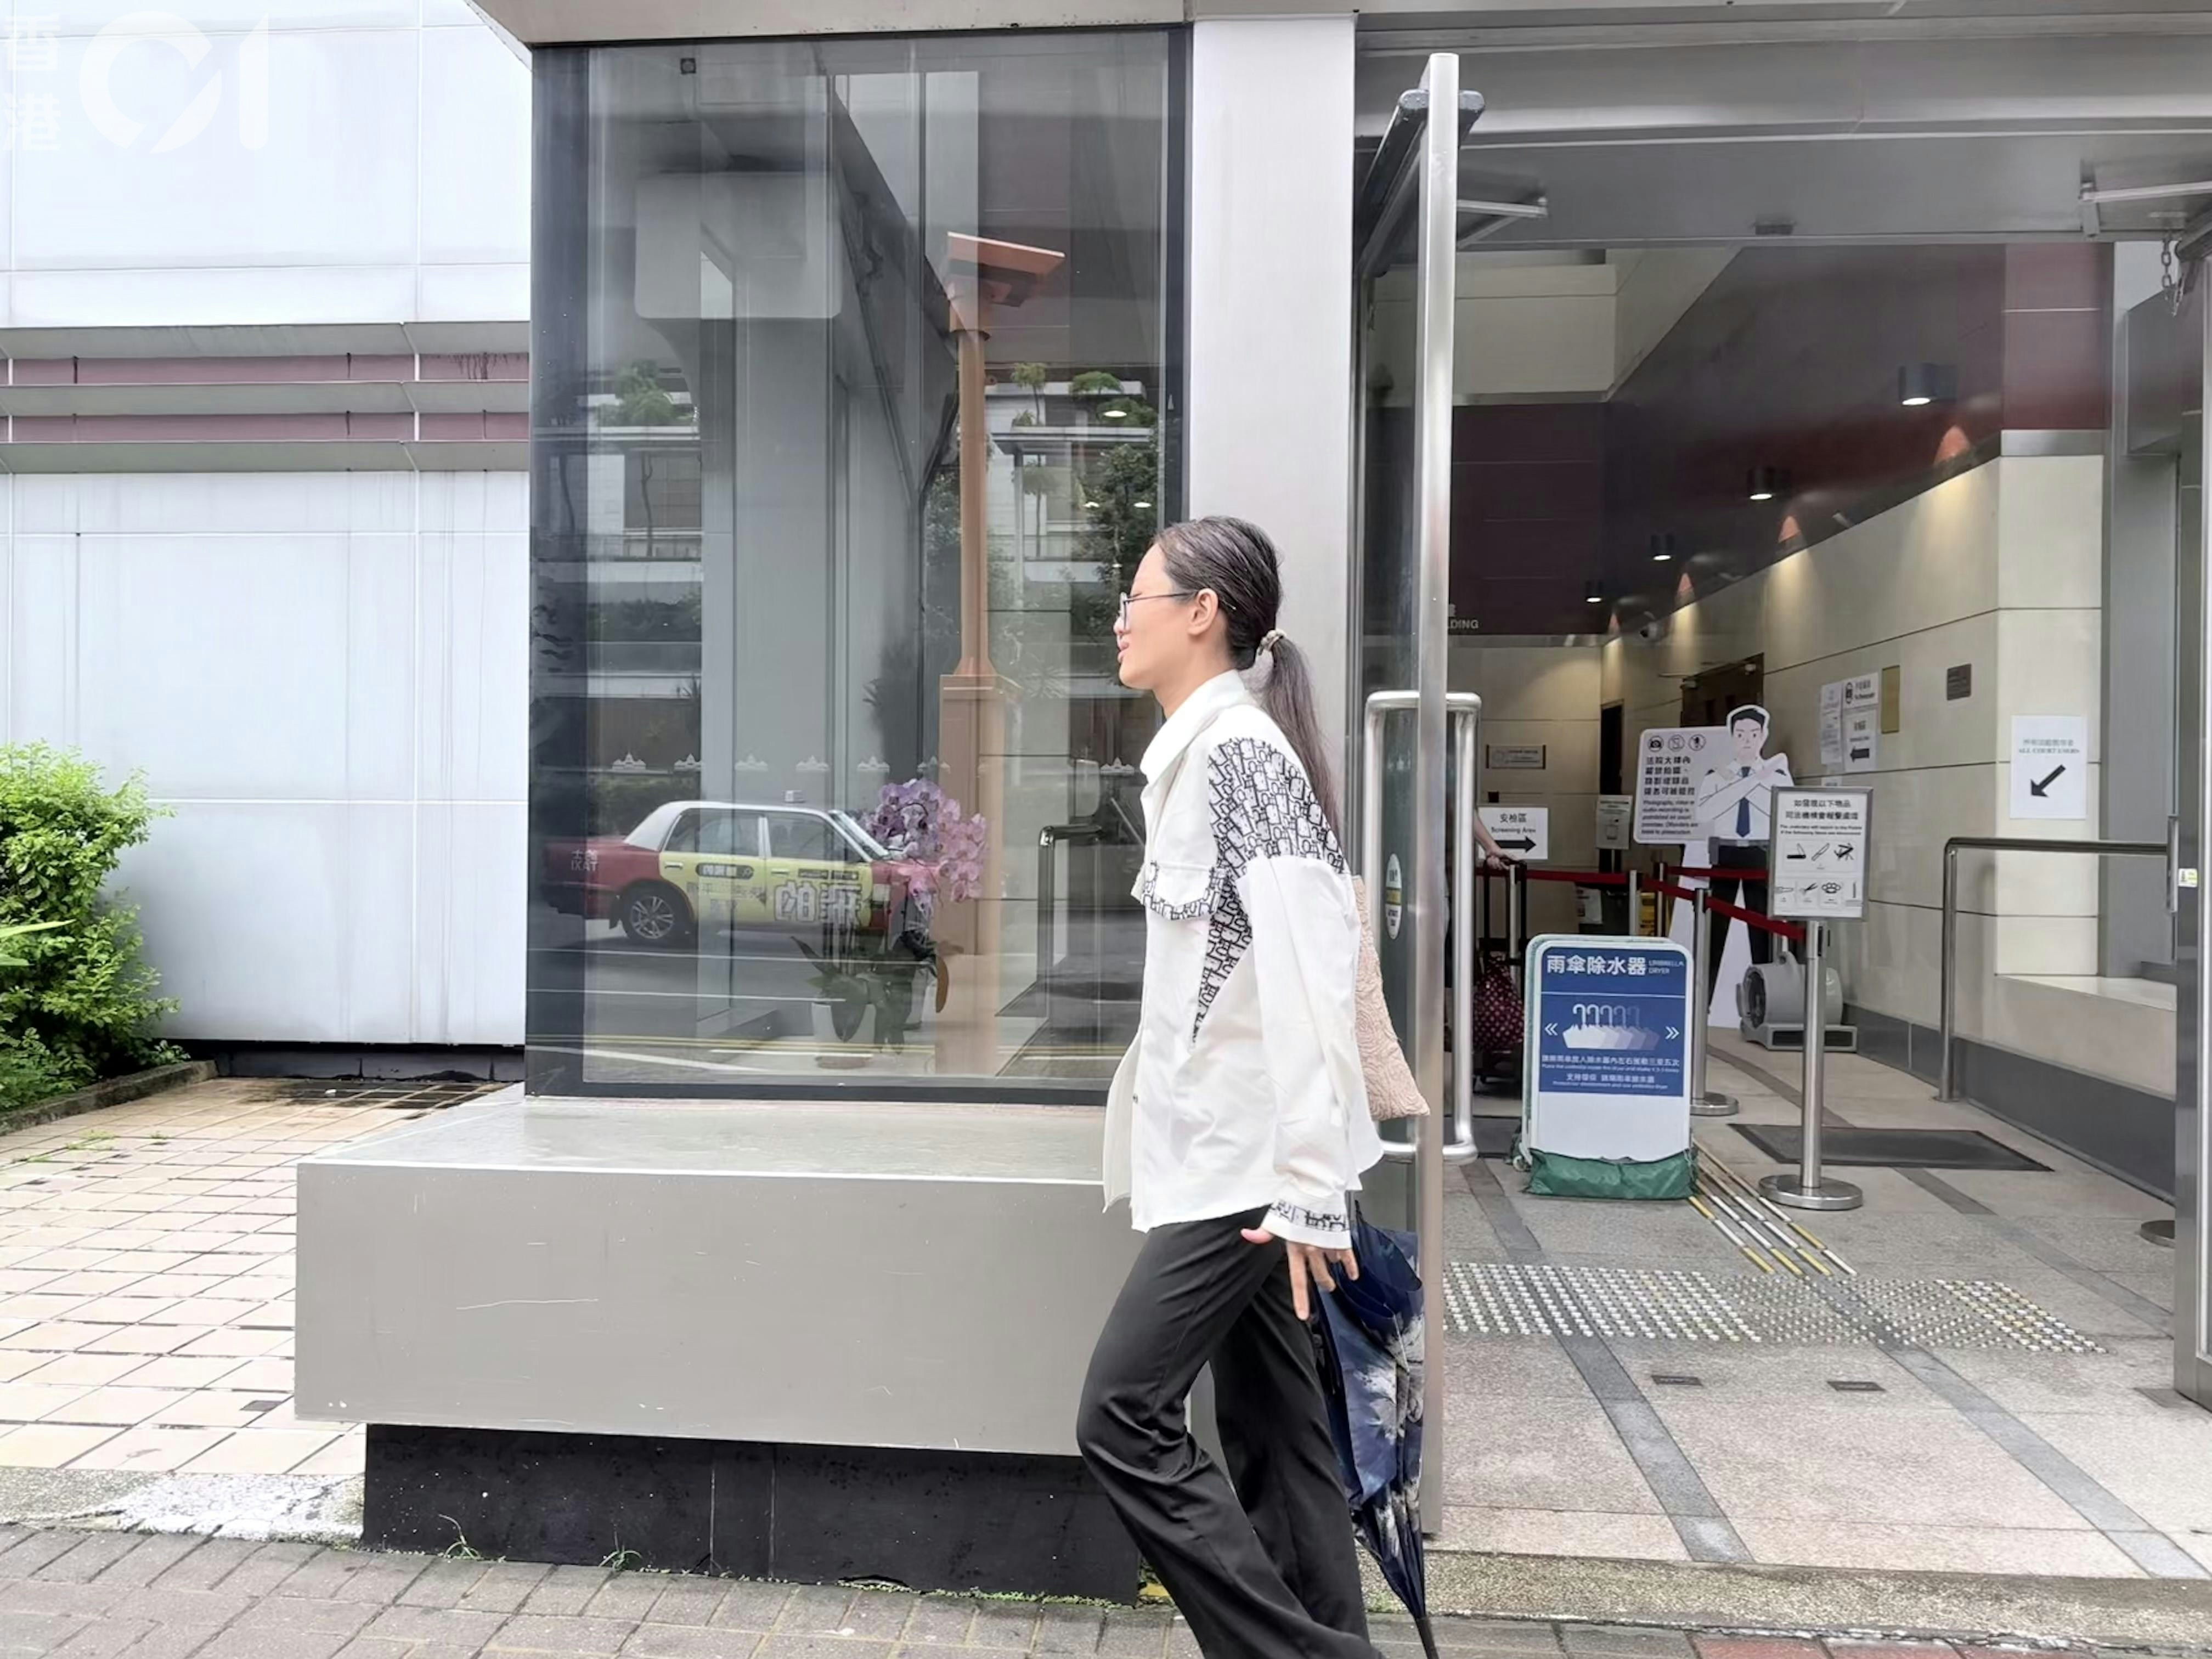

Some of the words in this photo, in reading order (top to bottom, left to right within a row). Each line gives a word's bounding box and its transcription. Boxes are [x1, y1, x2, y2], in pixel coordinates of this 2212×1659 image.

[1547, 955, 1646, 975] 雨傘除水器
